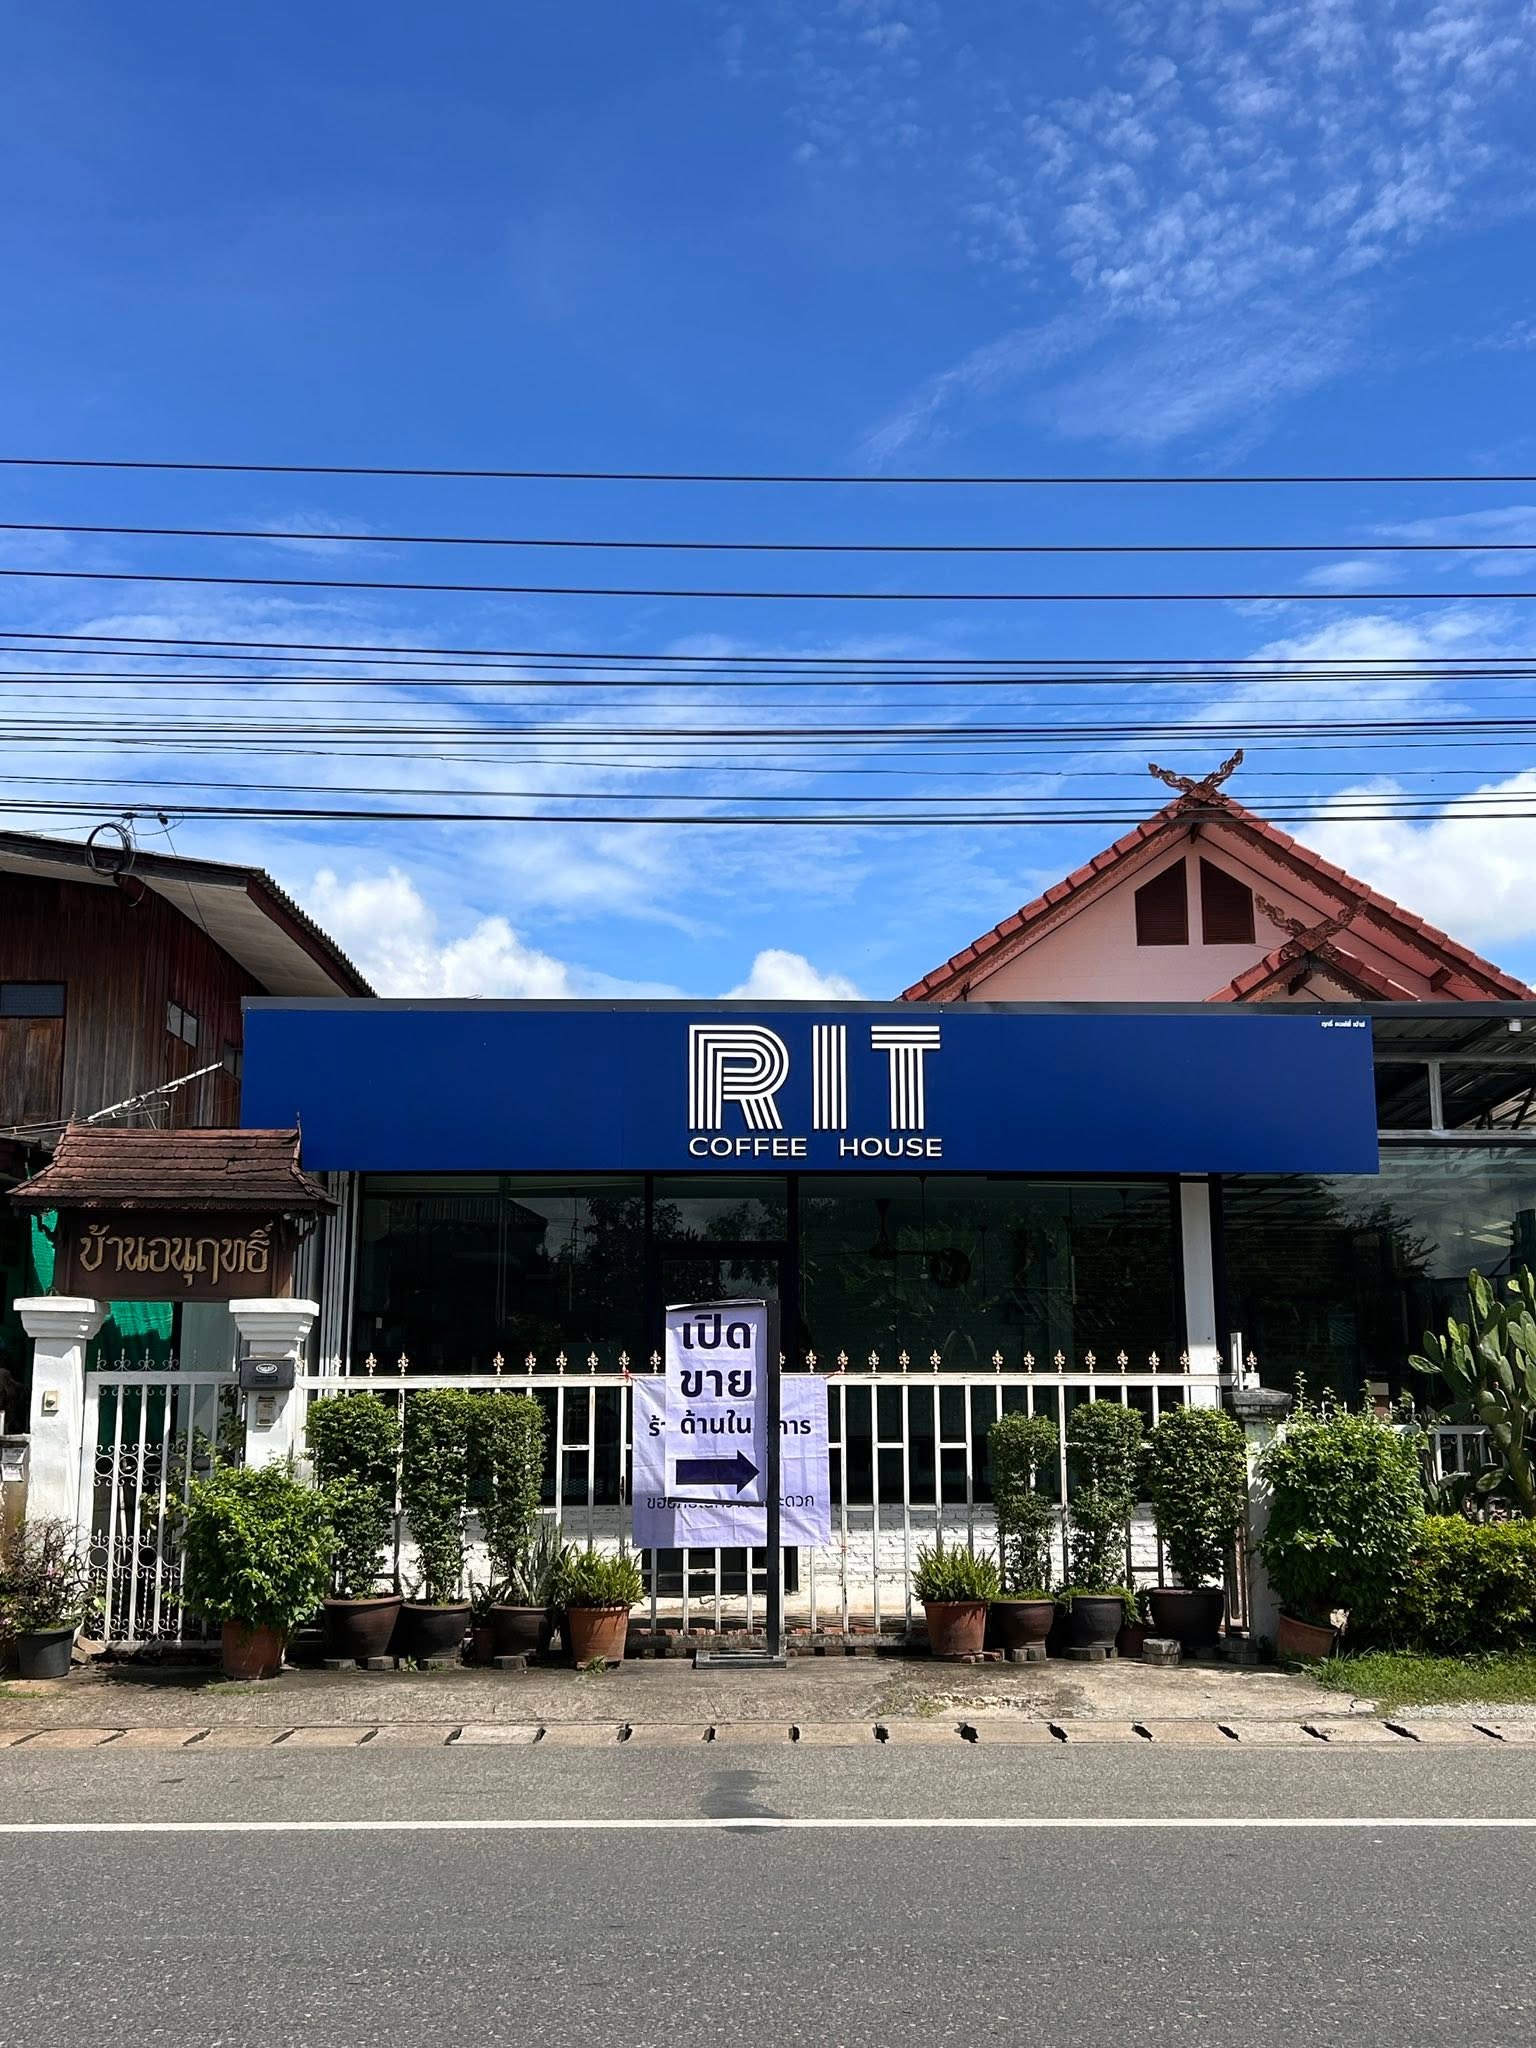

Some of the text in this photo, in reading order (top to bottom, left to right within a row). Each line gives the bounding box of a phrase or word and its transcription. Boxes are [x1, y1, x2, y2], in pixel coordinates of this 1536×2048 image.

[689, 1024, 941, 1130] RIT
[689, 1137, 943, 1157] COFFEE HOUSE
[79, 1222, 274, 1287] บ้านอนุฤทธิ์
[683, 1313, 751, 1350] เปิด
[680, 1370, 752, 1398] ขาย
[680, 1409, 752, 1434] ด้านใน
